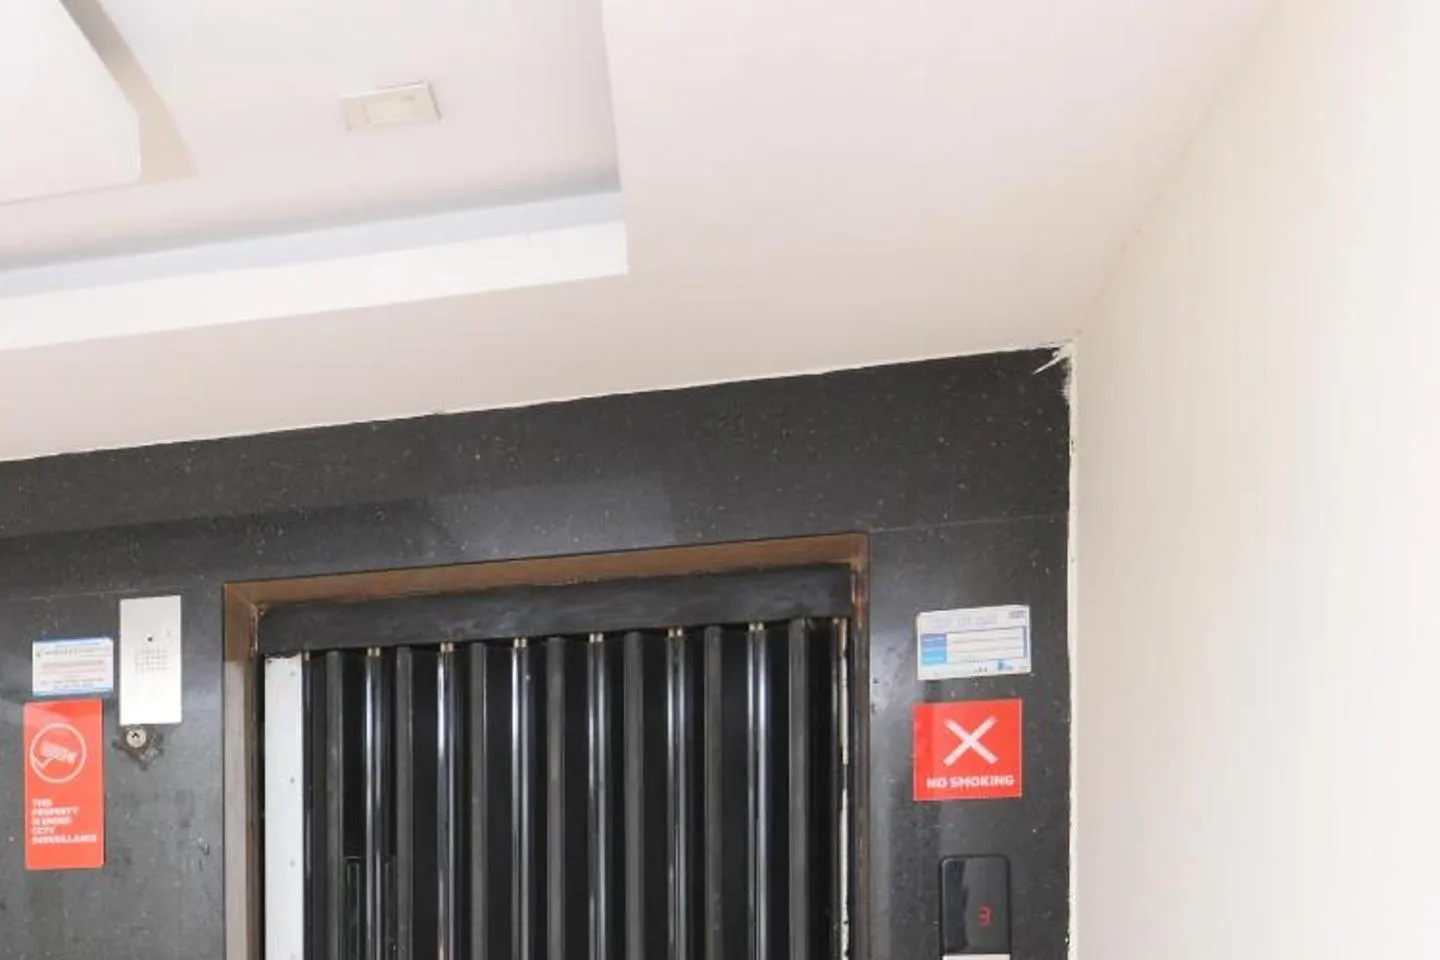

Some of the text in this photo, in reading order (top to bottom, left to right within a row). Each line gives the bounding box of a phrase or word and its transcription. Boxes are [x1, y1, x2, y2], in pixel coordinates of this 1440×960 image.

[926, 774, 1014, 788] NO SMOKING
[32, 807, 79, 817] PROPERTY
[978, 905, 993, 926] 3
